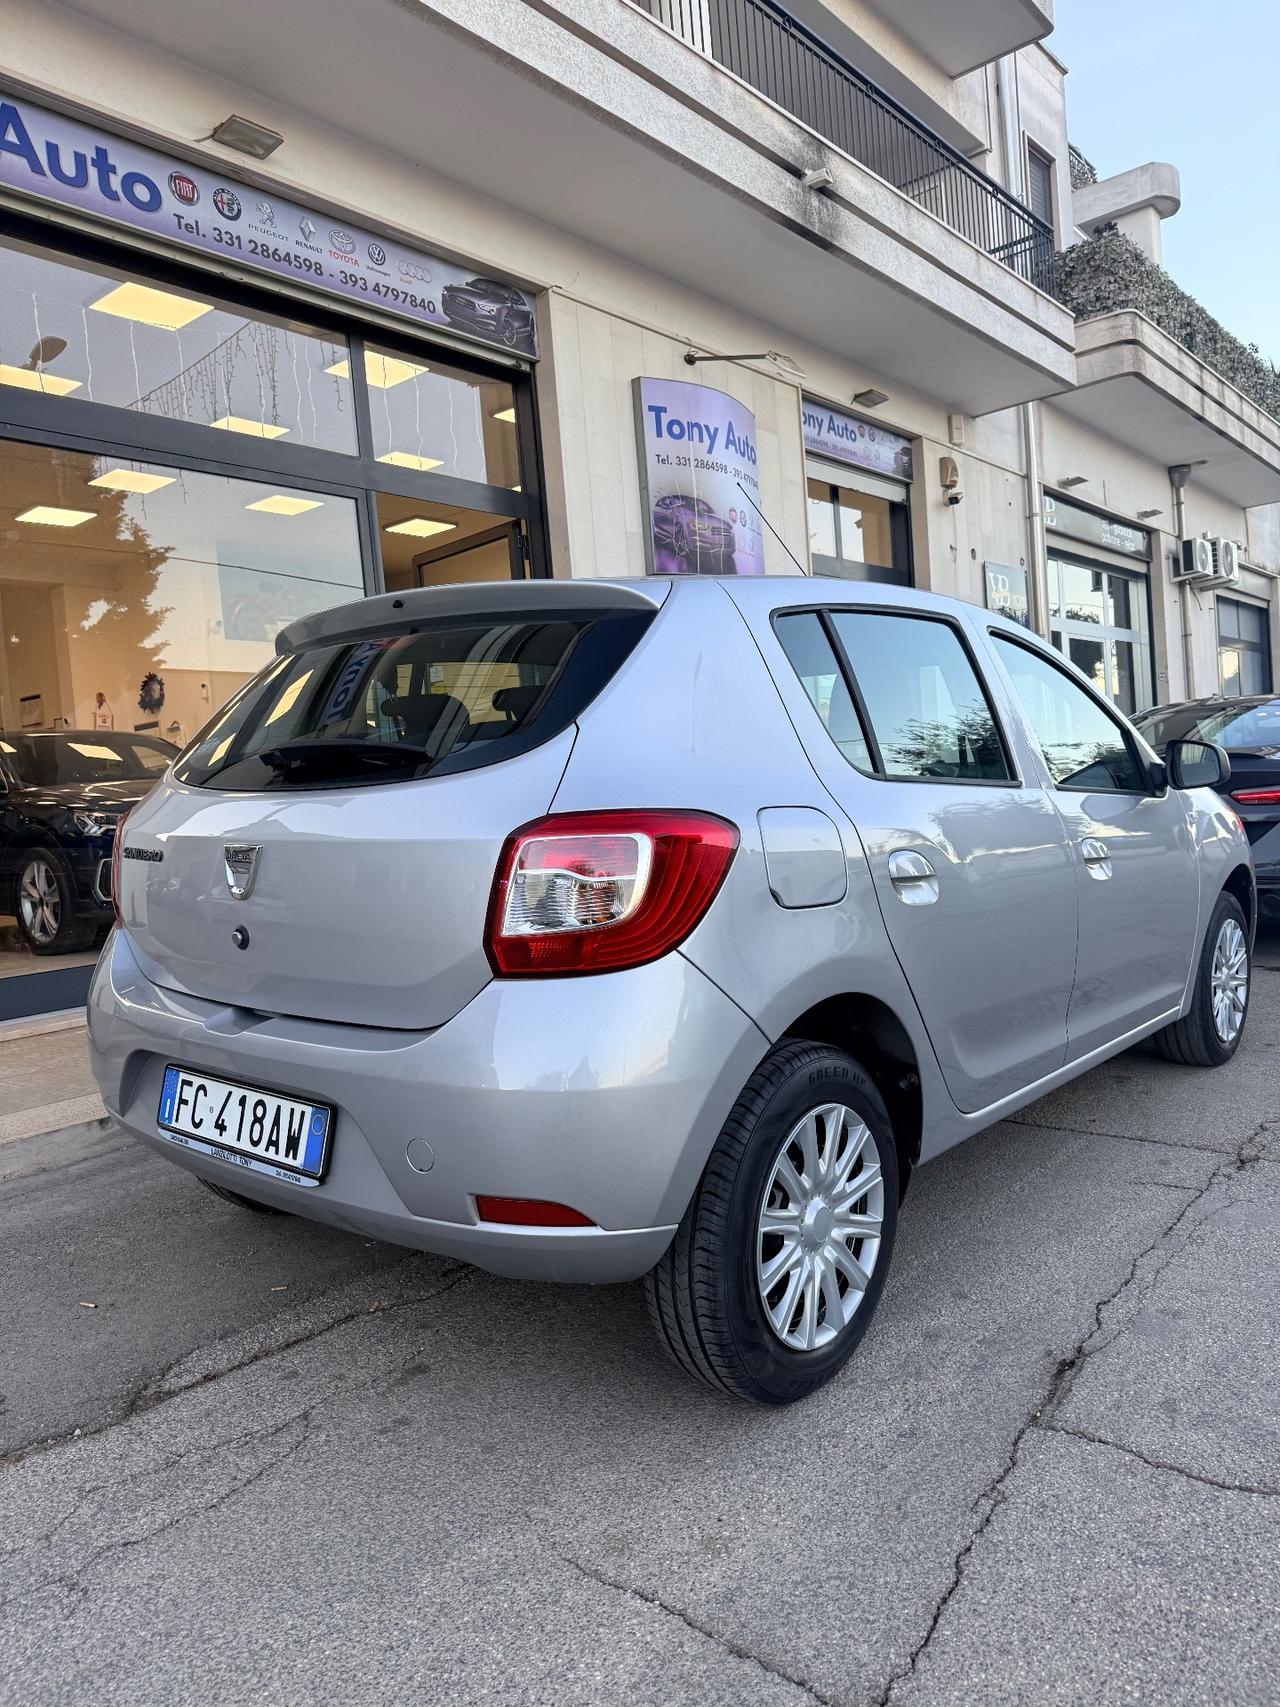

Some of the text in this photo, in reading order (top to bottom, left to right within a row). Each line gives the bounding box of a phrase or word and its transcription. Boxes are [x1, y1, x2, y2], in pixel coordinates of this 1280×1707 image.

[0, 103, 163, 212] Auto
[175, 179, 194, 198] FIAT
[248, 223, 290, 242] PEUGEOT
[295, 239, 323, 255] RENAULT
[328, 250, 360, 268] TOYOTA
[173, 213, 207, 238] Tel.
[212, 227, 243, 250] 331
[248, 239, 324, 277] 2864598
[339, 270, 369, 291] 393
[372, 282, 436, 314] 4797840
[648, 405, 757, 465] Tony Auto
[827, 414, 857, 443] Auto
[655, 454, 673, 465] Tel.
[675, 456, 691, 467] 331
[694, 458, 728, 474] 2864598
[175, 1078, 306, 1161] FC 418AW
